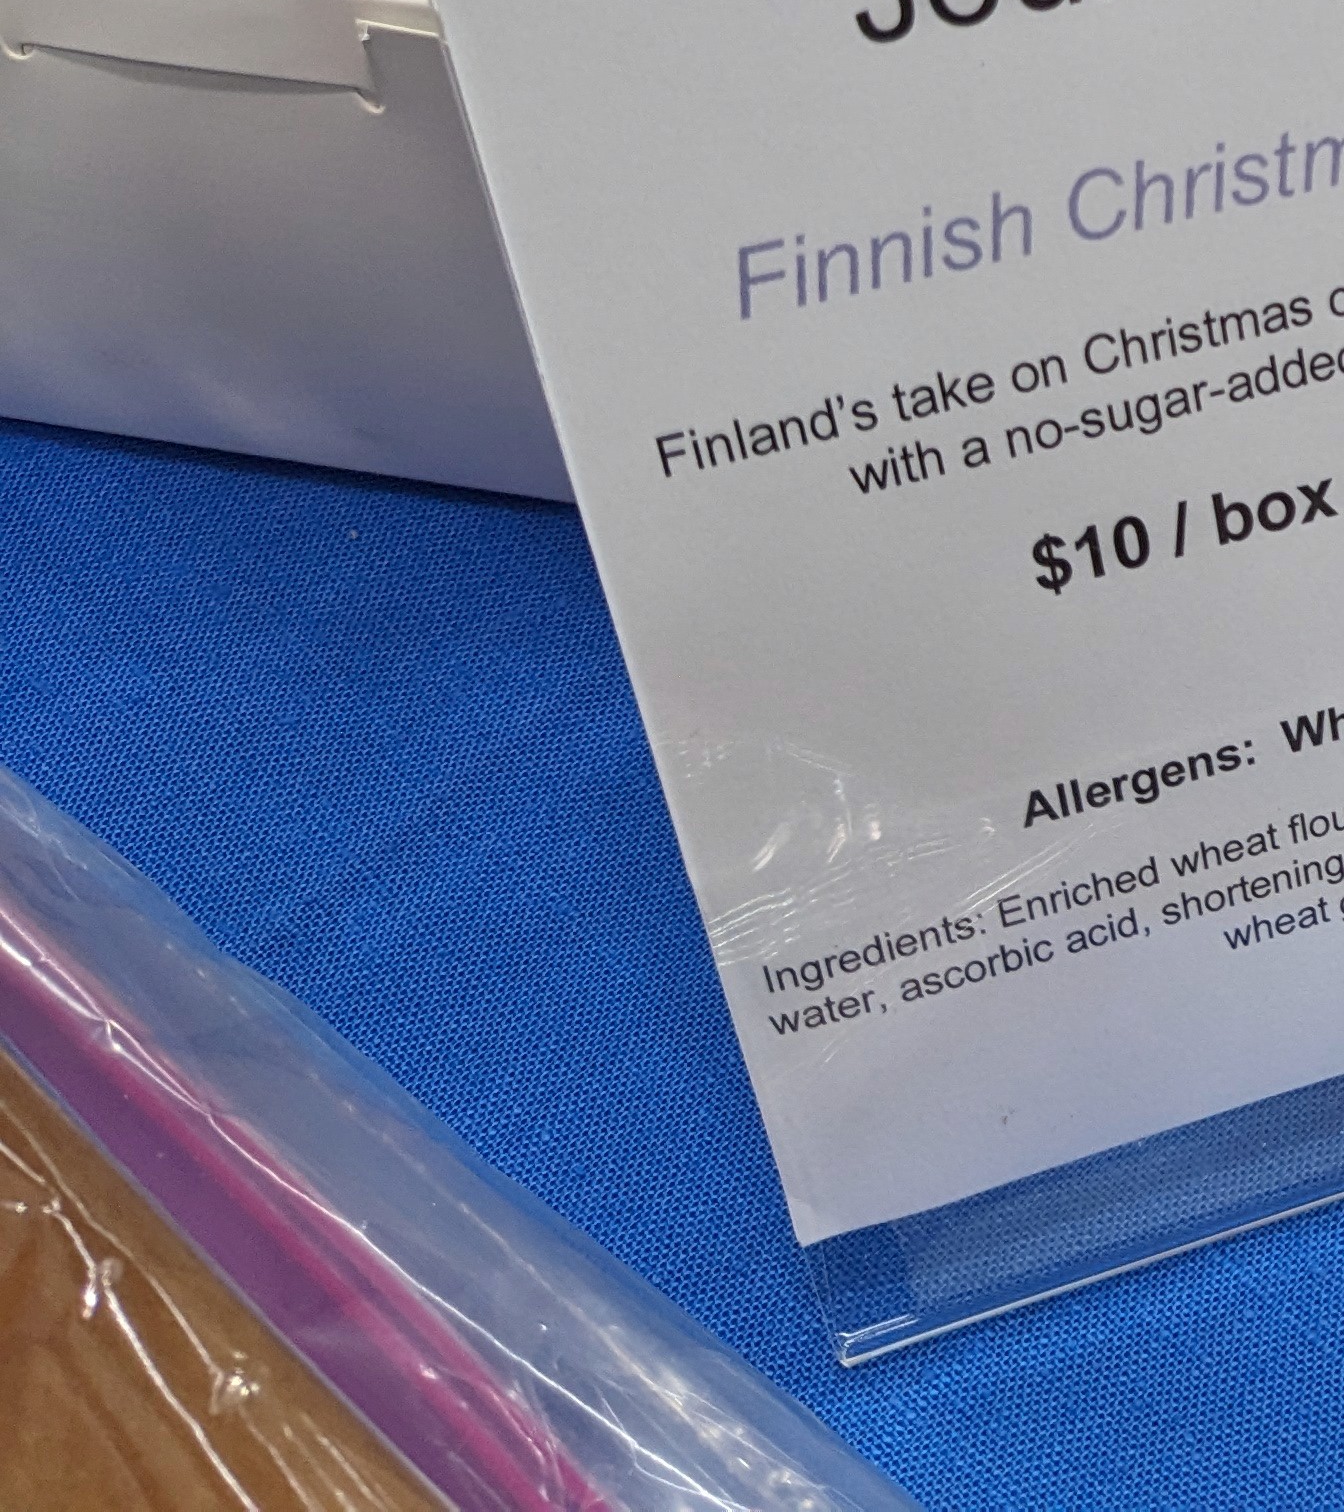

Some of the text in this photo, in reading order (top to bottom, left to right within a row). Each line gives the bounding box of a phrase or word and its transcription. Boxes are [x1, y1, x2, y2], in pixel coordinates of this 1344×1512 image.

[737, 191, 1033, 321] Finnish
[654, 393, 879, 479] Finland's
[891, 370, 996, 422] take
[1011, 354, 1069, 394] on
[1083, 295, 1314, 375] Christmas
[847, 440, 946, 495] with
[961, 435, 992, 470] a
[1031, 515, 1150, 597] $10
[1173, 499, 1188, 559] /
[1210, 477, 1339, 546] box
[1023, 739, 1256, 829] Allergens:
[761, 898, 987, 994] Ingredients:
[996, 855, 1161, 929] Enriched
[1169, 822, 1281, 878] wheat
[1222, 896, 1332, 951] wheat
[767, 989, 888, 1036] water,
[899, 937, 1055, 1003] ascorbic
[1065, 906, 1151, 955] acid,
